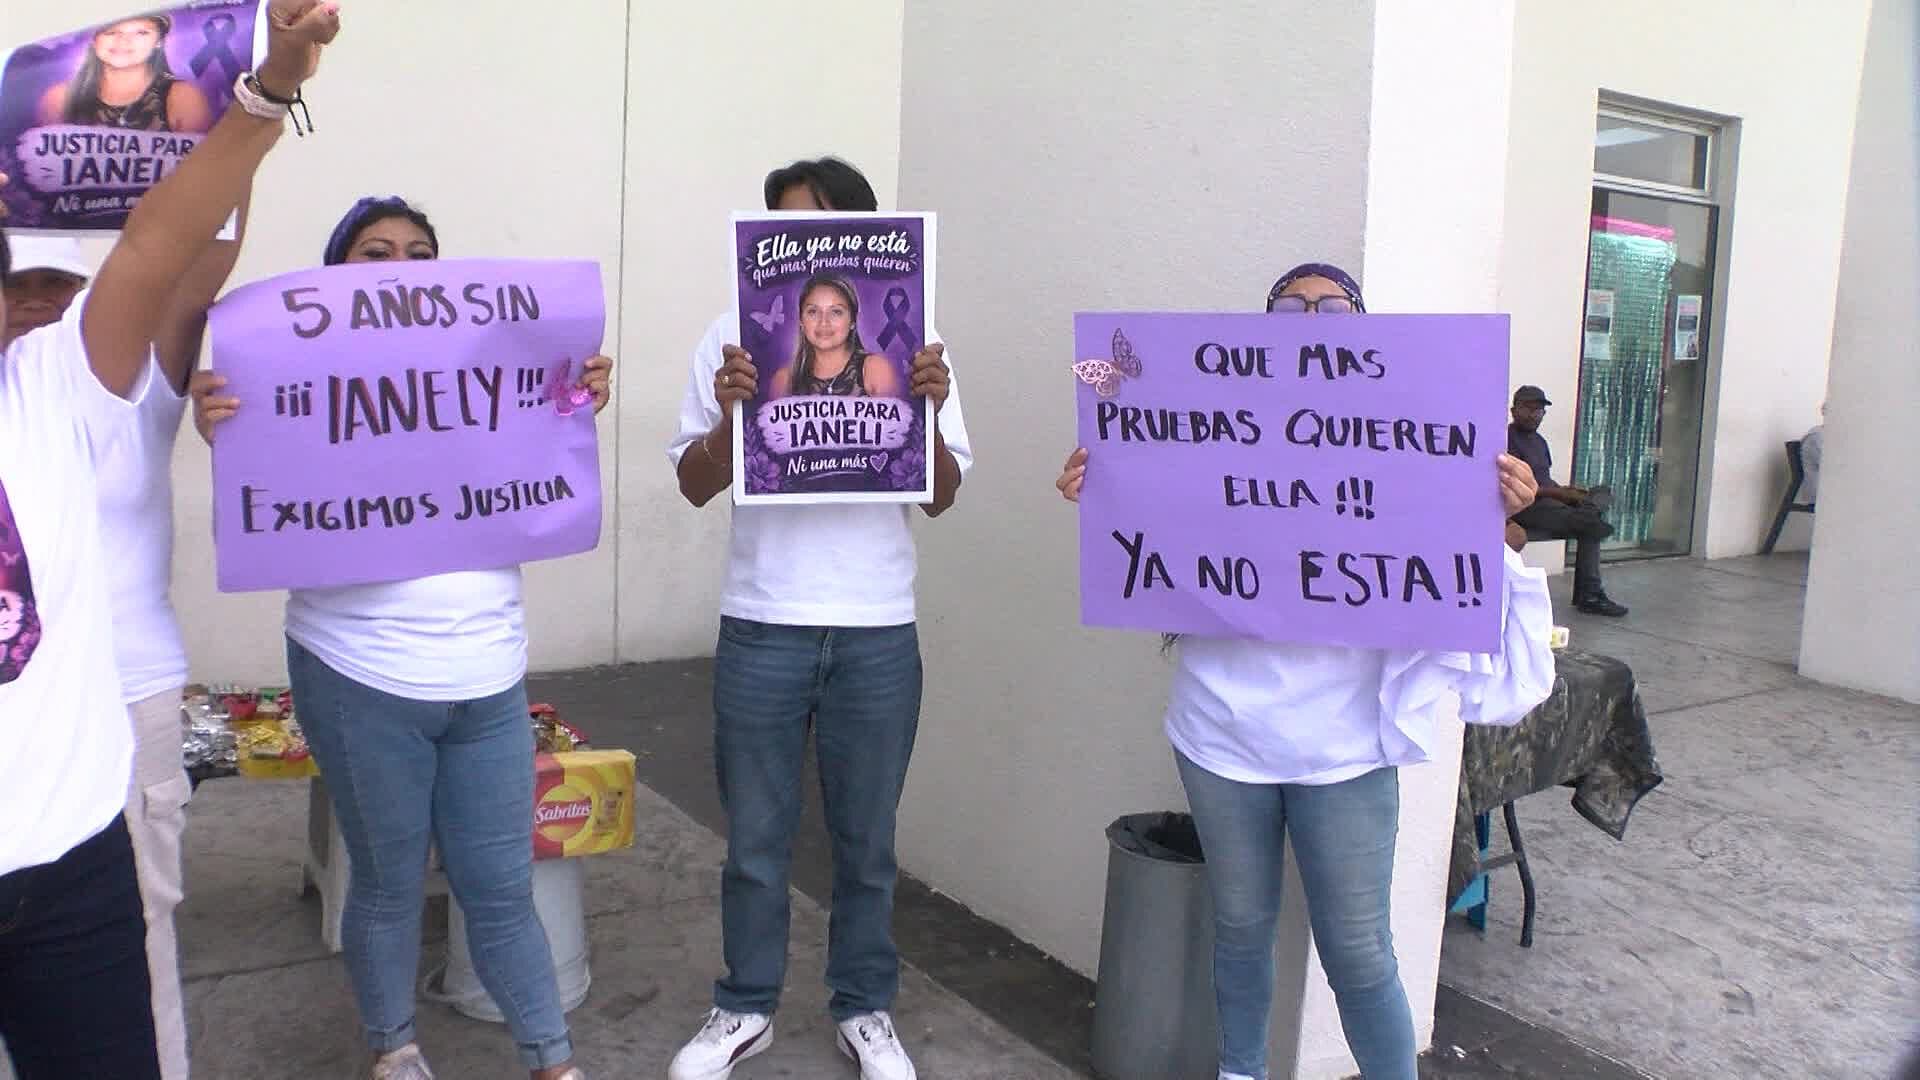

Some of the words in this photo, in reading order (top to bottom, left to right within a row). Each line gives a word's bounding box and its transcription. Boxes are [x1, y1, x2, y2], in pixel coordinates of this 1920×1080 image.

[35, 133, 140, 156] JUSTICIA
[152, 137, 195, 156] PAR
[62, 157, 181, 186] IANEL
[756, 233, 803, 267] Ella
[806, 236, 835, 262] ya
[838, 234, 864, 251] no
[867, 231, 911, 254] está
[753, 266, 777, 287] que
[780, 259, 807, 274] mas
[810, 253, 860, 273] pruebas
[863, 253, 911, 274] quieren
[282, 287, 332, 338] 5
[350, 277, 457, 330] AÑOS
[462, 283, 540, 327] SIN
[1194, 342, 1275, 379] QUE
[1298, 343, 1386, 380] MAS
[770, 401, 847, 424] JUSTICIA
[854, 401, 901, 422] PARA
[1097, 401, 1262, 444] PRUEBAS
[1285, 409, 1477, 457] QUIEREN
[790, 420, 882, 447] IANELI
[787, 455, 808, 476] Ni
[810, 459, 838, 471] una
[841, 453, 868, 469] más
[454, 475, 575, 521] JUSTICIA
[1112, 529, 1174, 599] YA
[1198, 555, 1260, 599] NO
[534, 802, 593, 824] Sabritas
